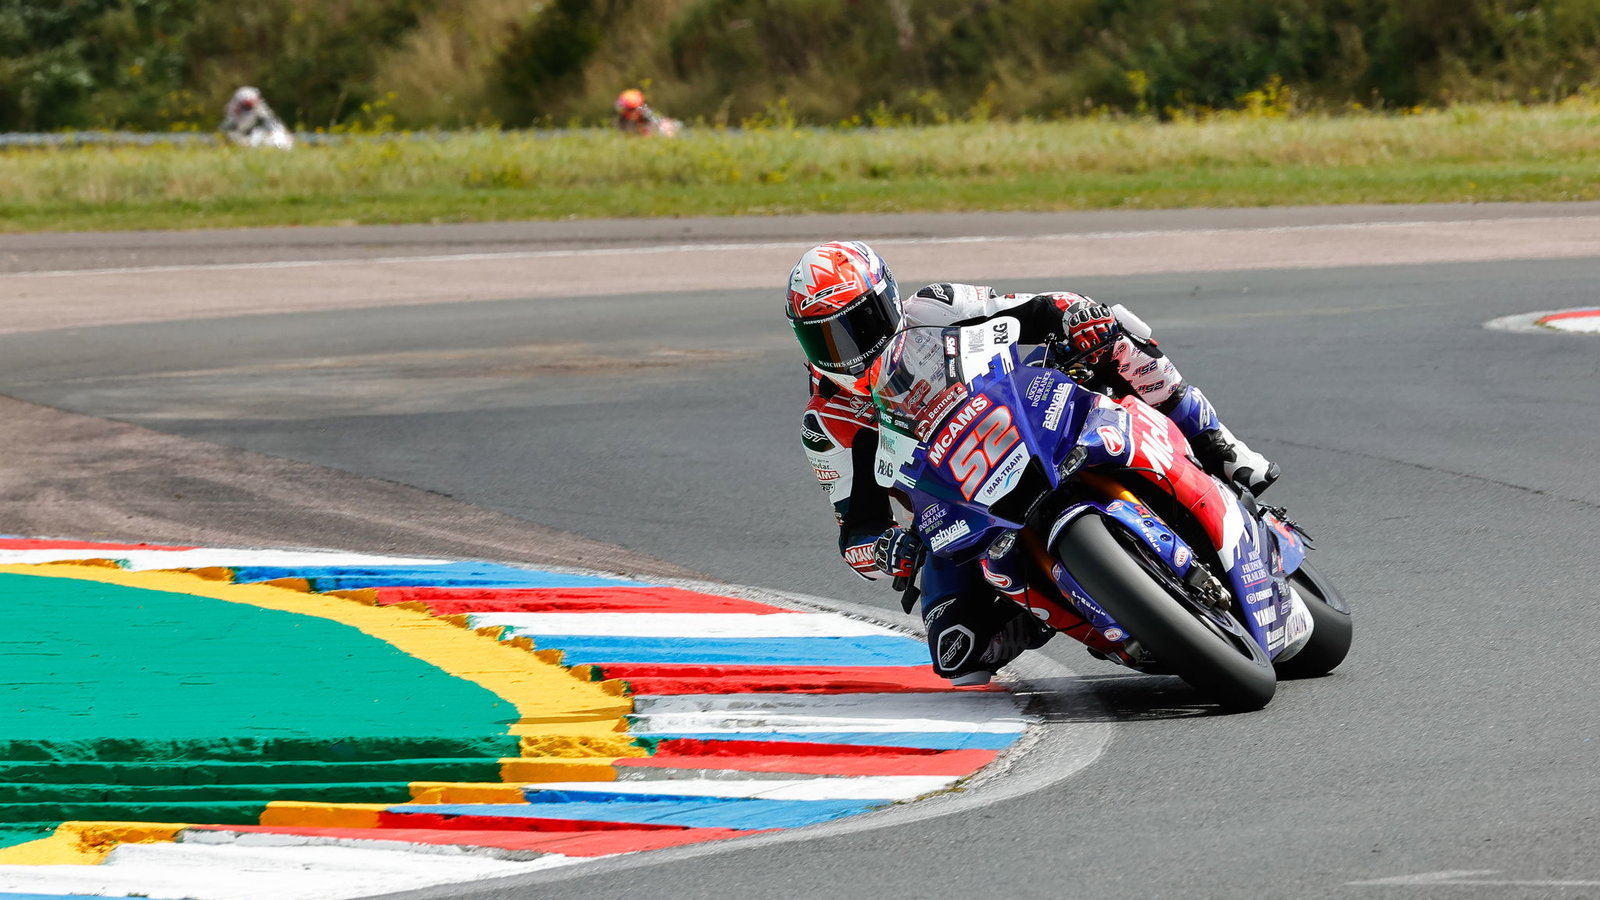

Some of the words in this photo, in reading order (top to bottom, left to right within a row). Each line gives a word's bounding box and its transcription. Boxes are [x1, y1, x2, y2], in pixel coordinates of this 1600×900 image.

[818, 359, 847, 369] WATCHES
[853, 335, 887, 364] DISTINCTION
[928, 387, 963, 419] Bennets
[1027, 375, 1043, 401] ASCOTT
[1031, 370, 1052, 407] INSURANCE
[1042, 382, 1065, 430] ashvale
[929, 396, 988, 464] McAMS
[948, 405, 1021, 502] 52
[986, 453, 1024, 495] MAR-TRAIN
[918, 508, 947, 532] INSURANCE
[921, 503, 940, 522] ASCOTT
[930, 519, 967, 545] ashvale
[1072, 590, 1106, 616] PIRELLI
[940, 633, 964, 667] RST
